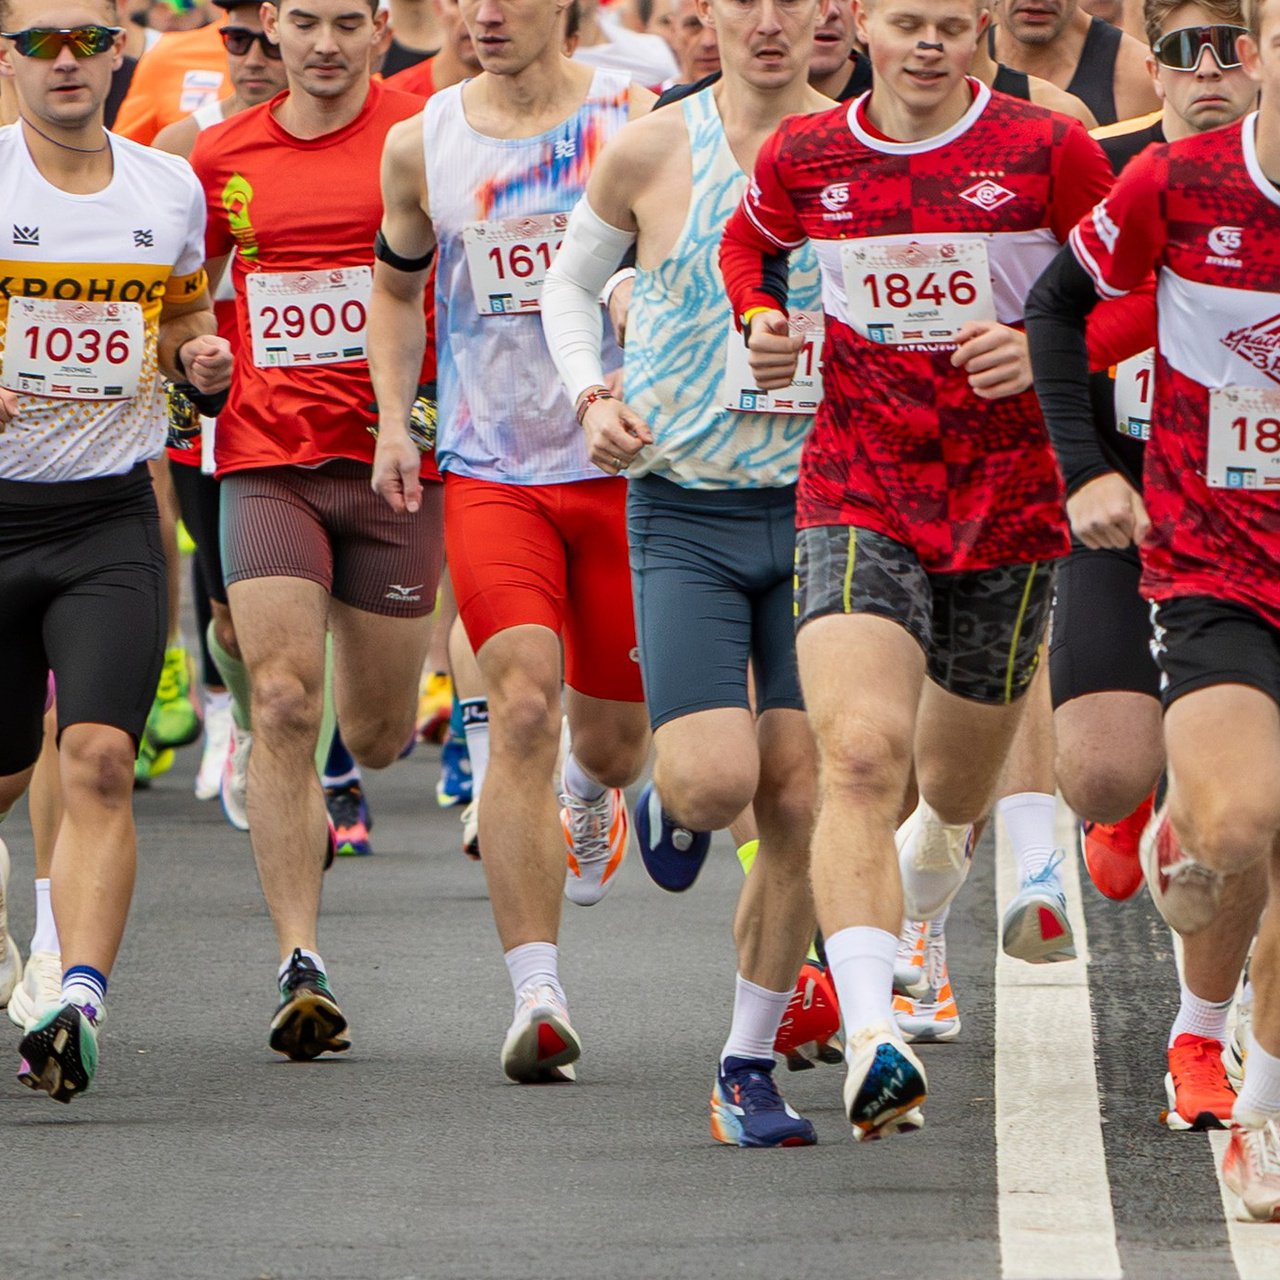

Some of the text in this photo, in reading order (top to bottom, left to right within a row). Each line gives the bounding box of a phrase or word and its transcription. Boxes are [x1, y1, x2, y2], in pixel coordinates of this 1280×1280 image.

[488, 240, 563, 279] 161
[1218, 232, 1243, 249] 35
[863, 270, 977, 308] 1846
[260, 300, 366, 338] 2900
[25, 326, 130, 364] 1036
